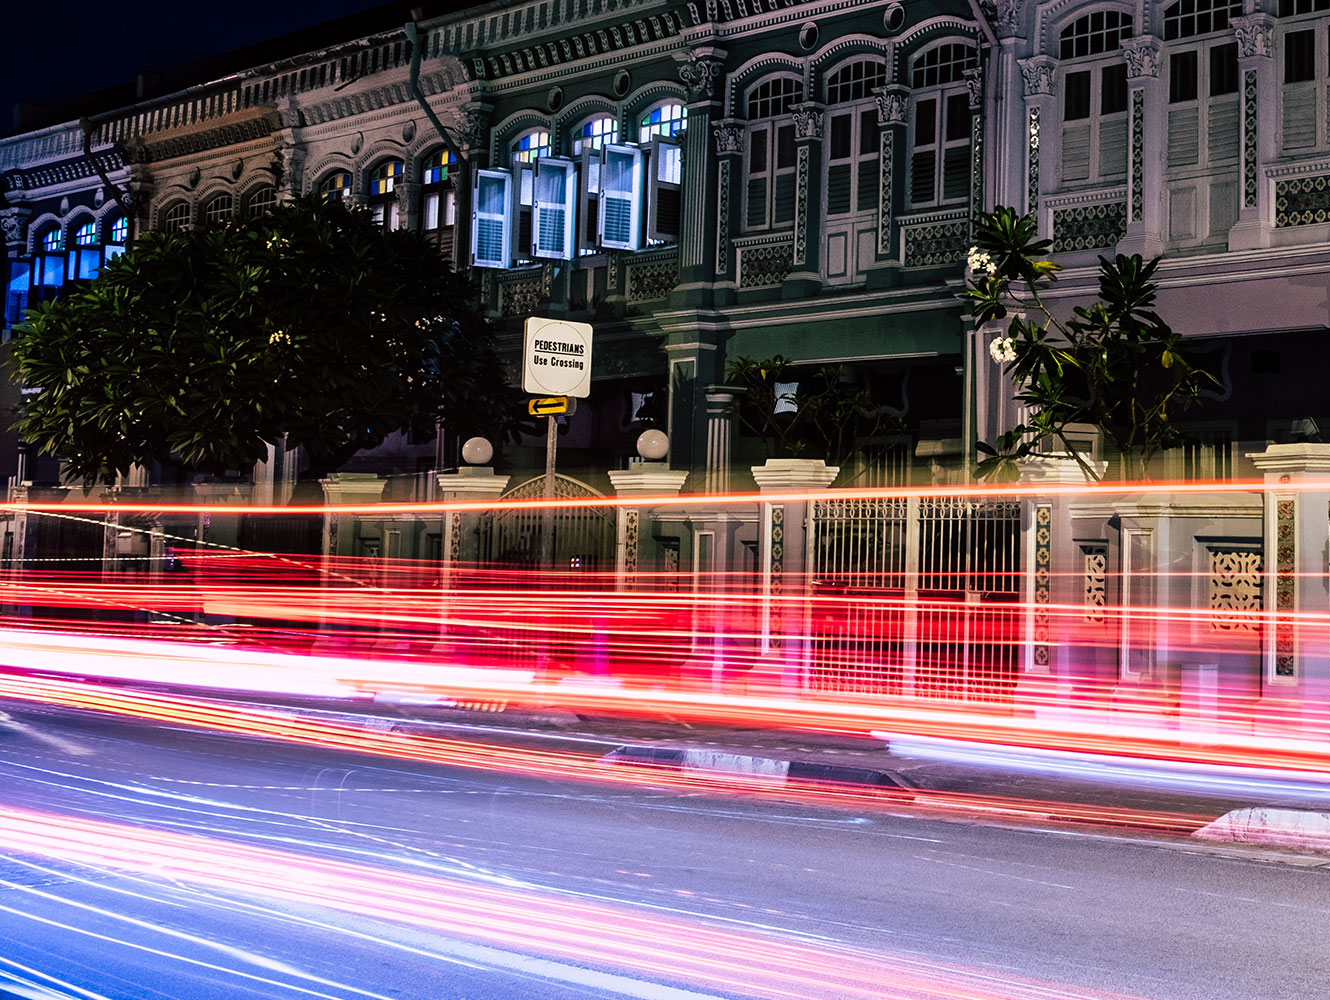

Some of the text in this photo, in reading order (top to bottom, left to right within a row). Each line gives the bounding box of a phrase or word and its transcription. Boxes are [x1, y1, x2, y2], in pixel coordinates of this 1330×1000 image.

[534, 339, 585, 354] PEDESTRIANS
[533, 355, 584, 371] Use Crossing
